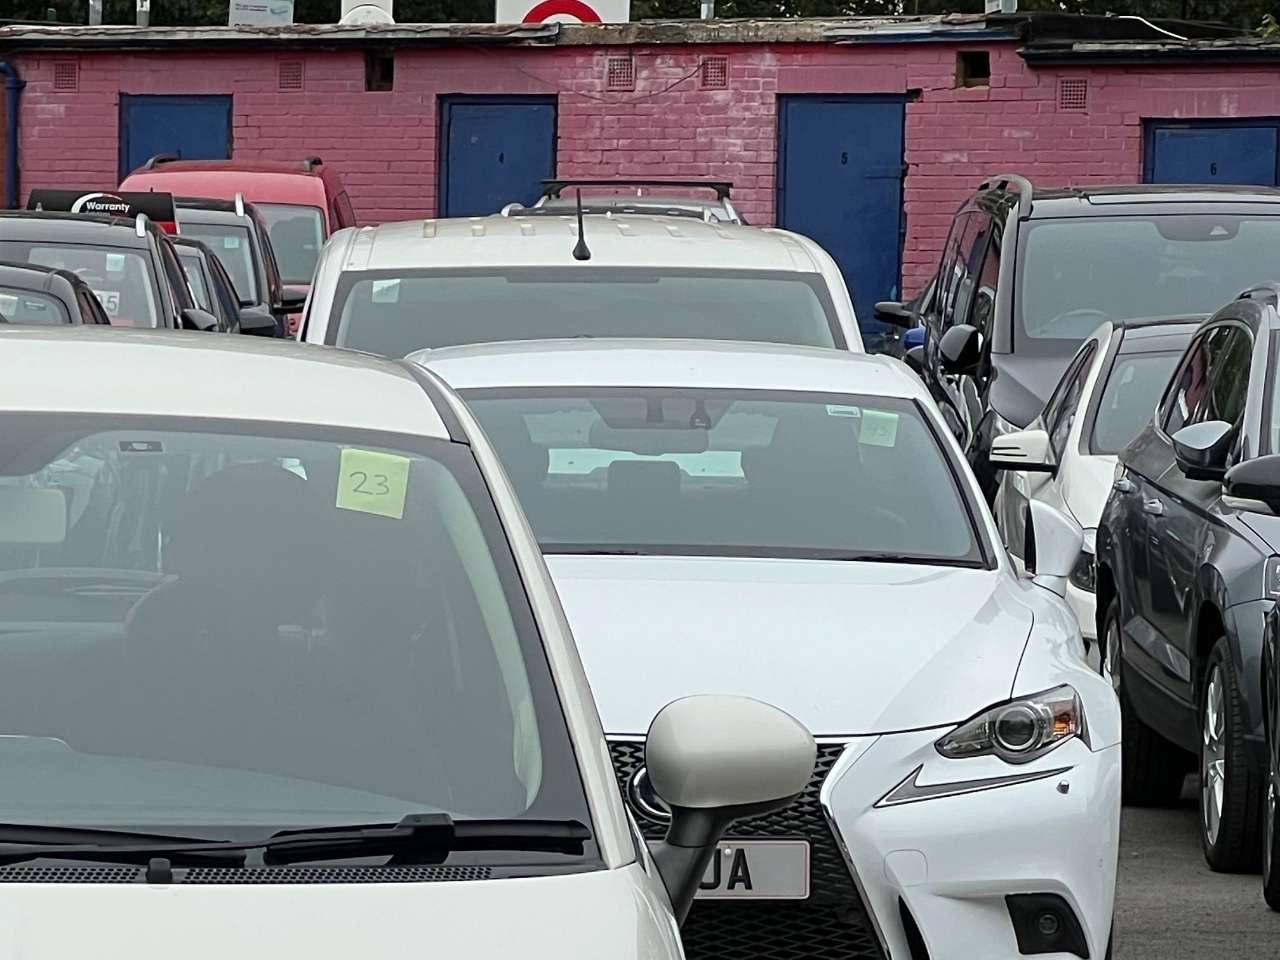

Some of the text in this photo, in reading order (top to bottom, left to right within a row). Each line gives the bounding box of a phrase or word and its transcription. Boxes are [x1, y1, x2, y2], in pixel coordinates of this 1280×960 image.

[841, 151, 849, 166] 5
[1210, 162, 1217, 176] 6
[86, 201, 130, 213] Warranty
[349, 471, 390, 496] 23
